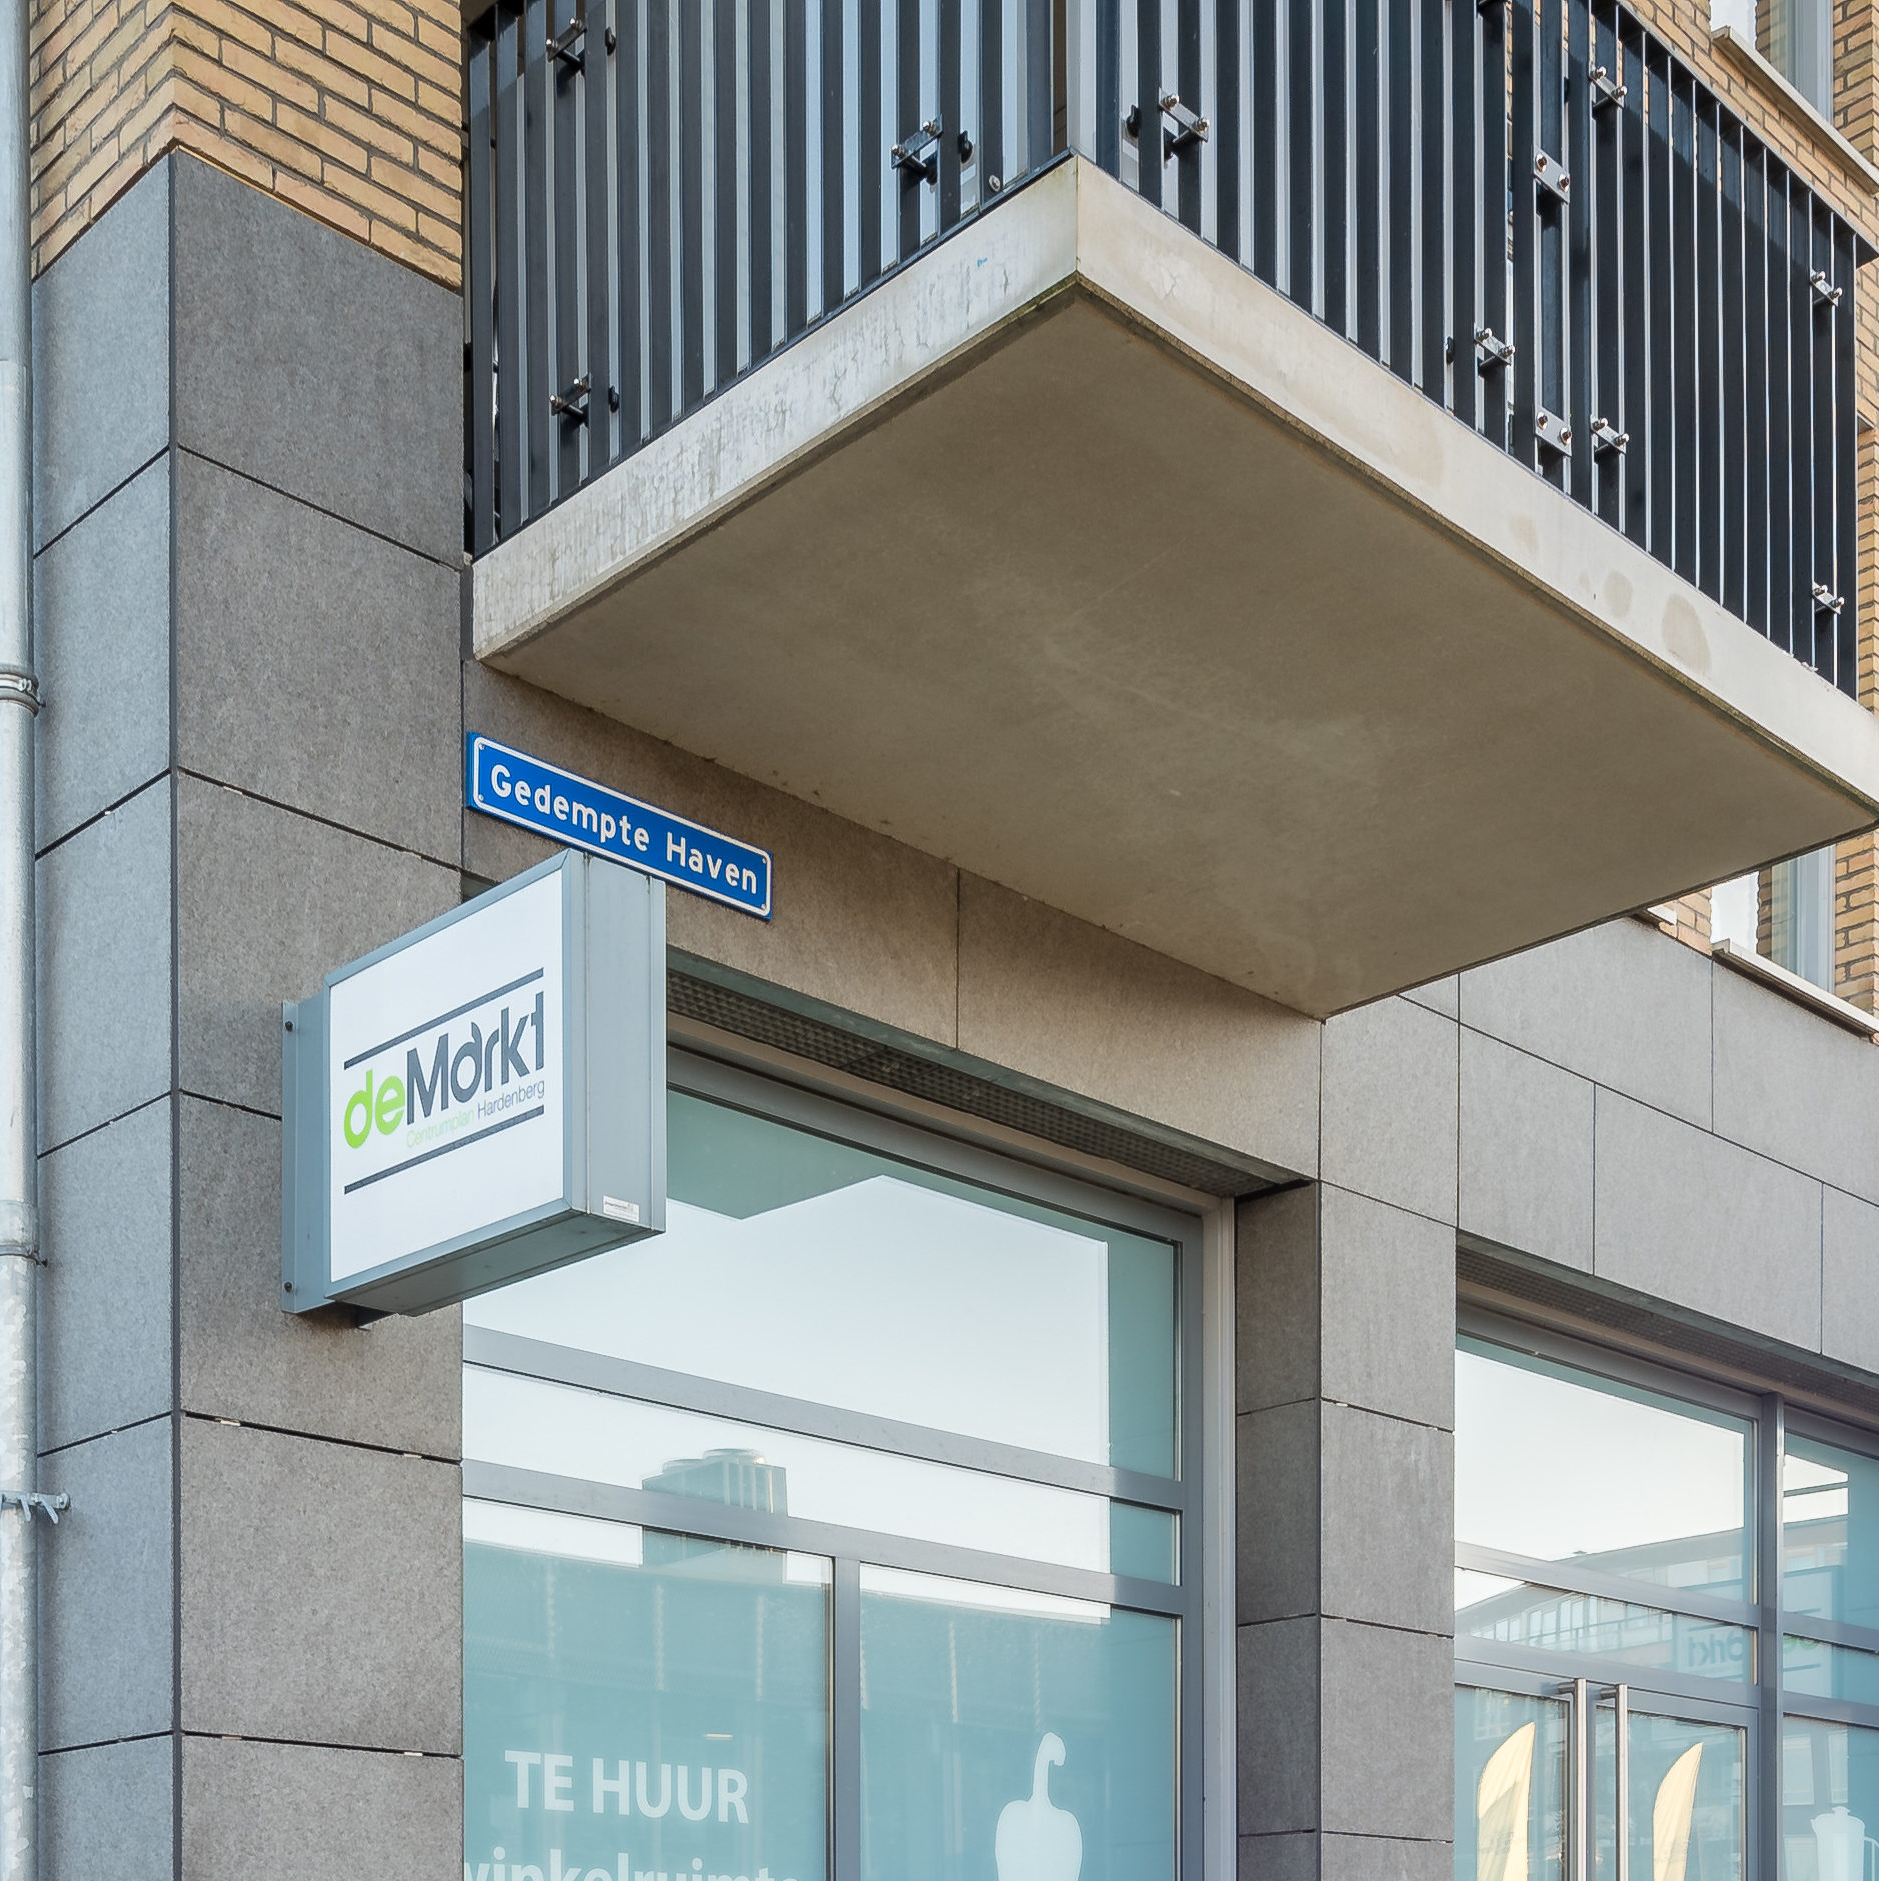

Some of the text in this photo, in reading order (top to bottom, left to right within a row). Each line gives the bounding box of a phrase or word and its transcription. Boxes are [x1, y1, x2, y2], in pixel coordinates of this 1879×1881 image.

[490, 764, 758, 895] Gedempte Haven
[406, 1079, 545, 1149] Centrumplan Hardenberg
[505, 1750, 749, 1824] TE HUUR
